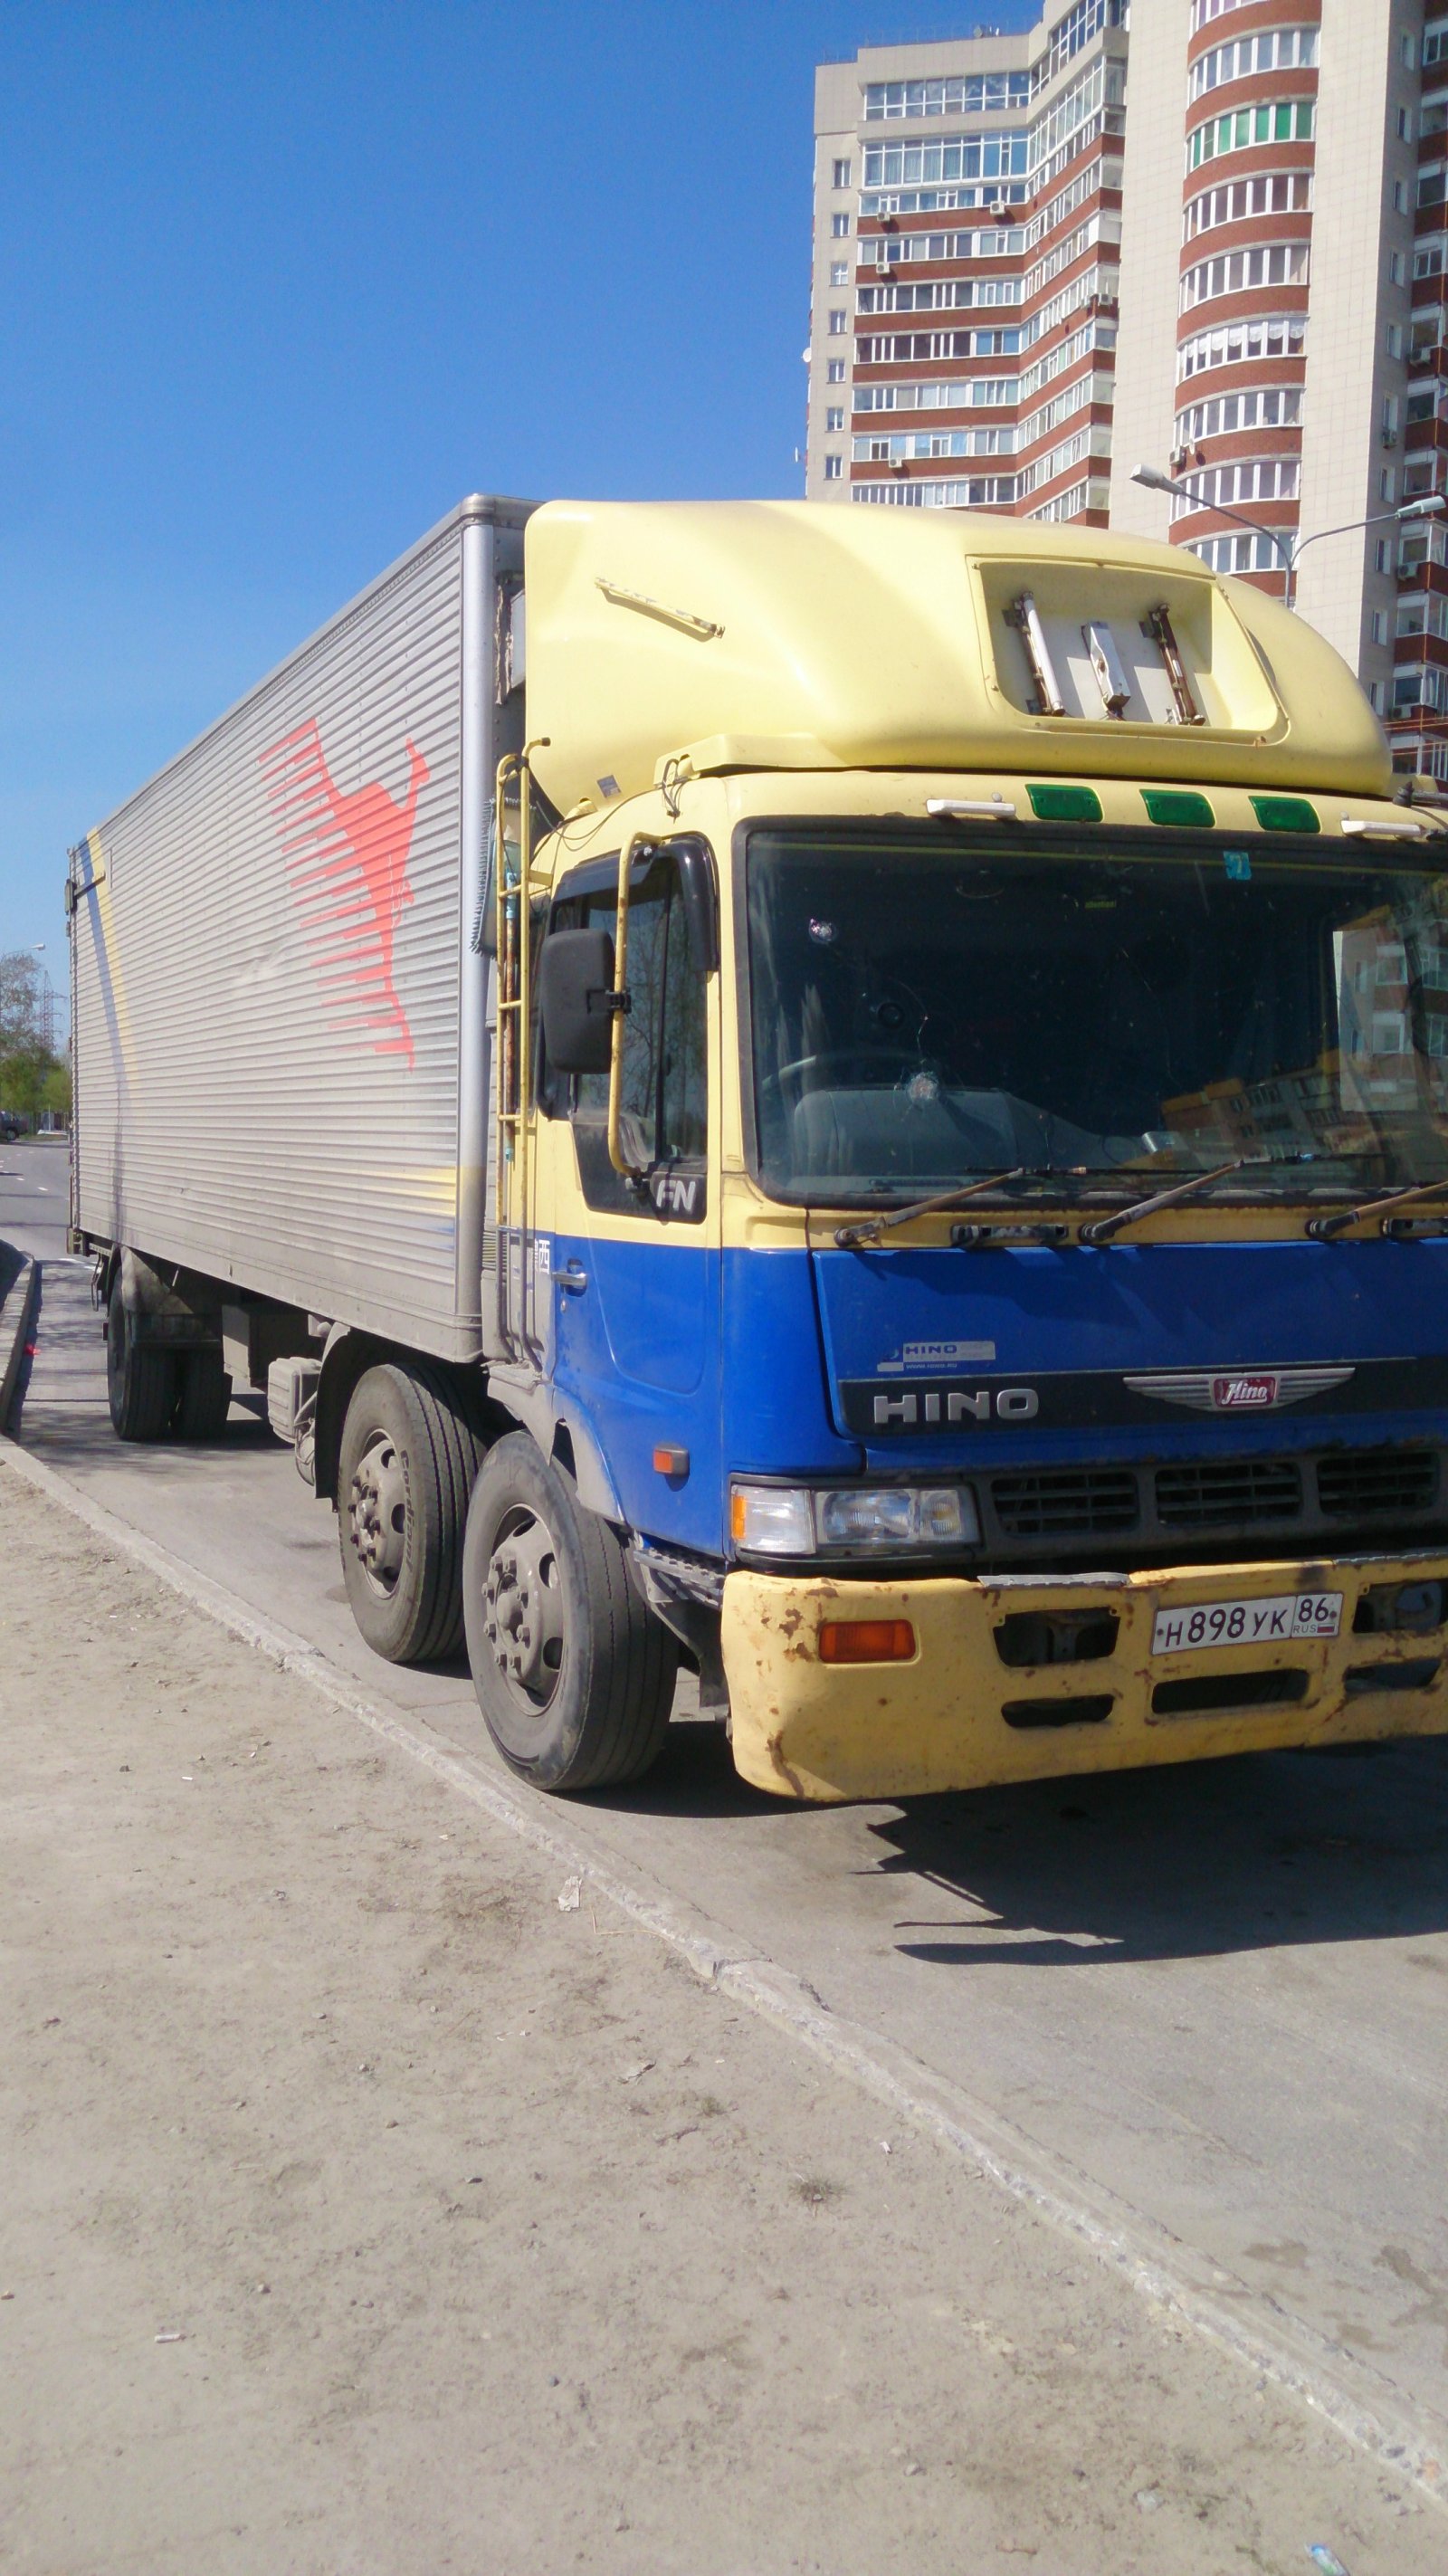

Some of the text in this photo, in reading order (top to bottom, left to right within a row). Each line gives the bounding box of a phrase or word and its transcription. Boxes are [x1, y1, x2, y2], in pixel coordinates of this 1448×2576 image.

[656, 1179, 696, 1212] FN
[905, 1344, 957, 1355] HINO
[873, 1388, 1039, 1424] HINO
[1221, 1379, 1268, 1405] Hino
[1165, 1598, 1329, 1647] Н898УК 86
[1292, 1624, 1317, 1635] RUS
